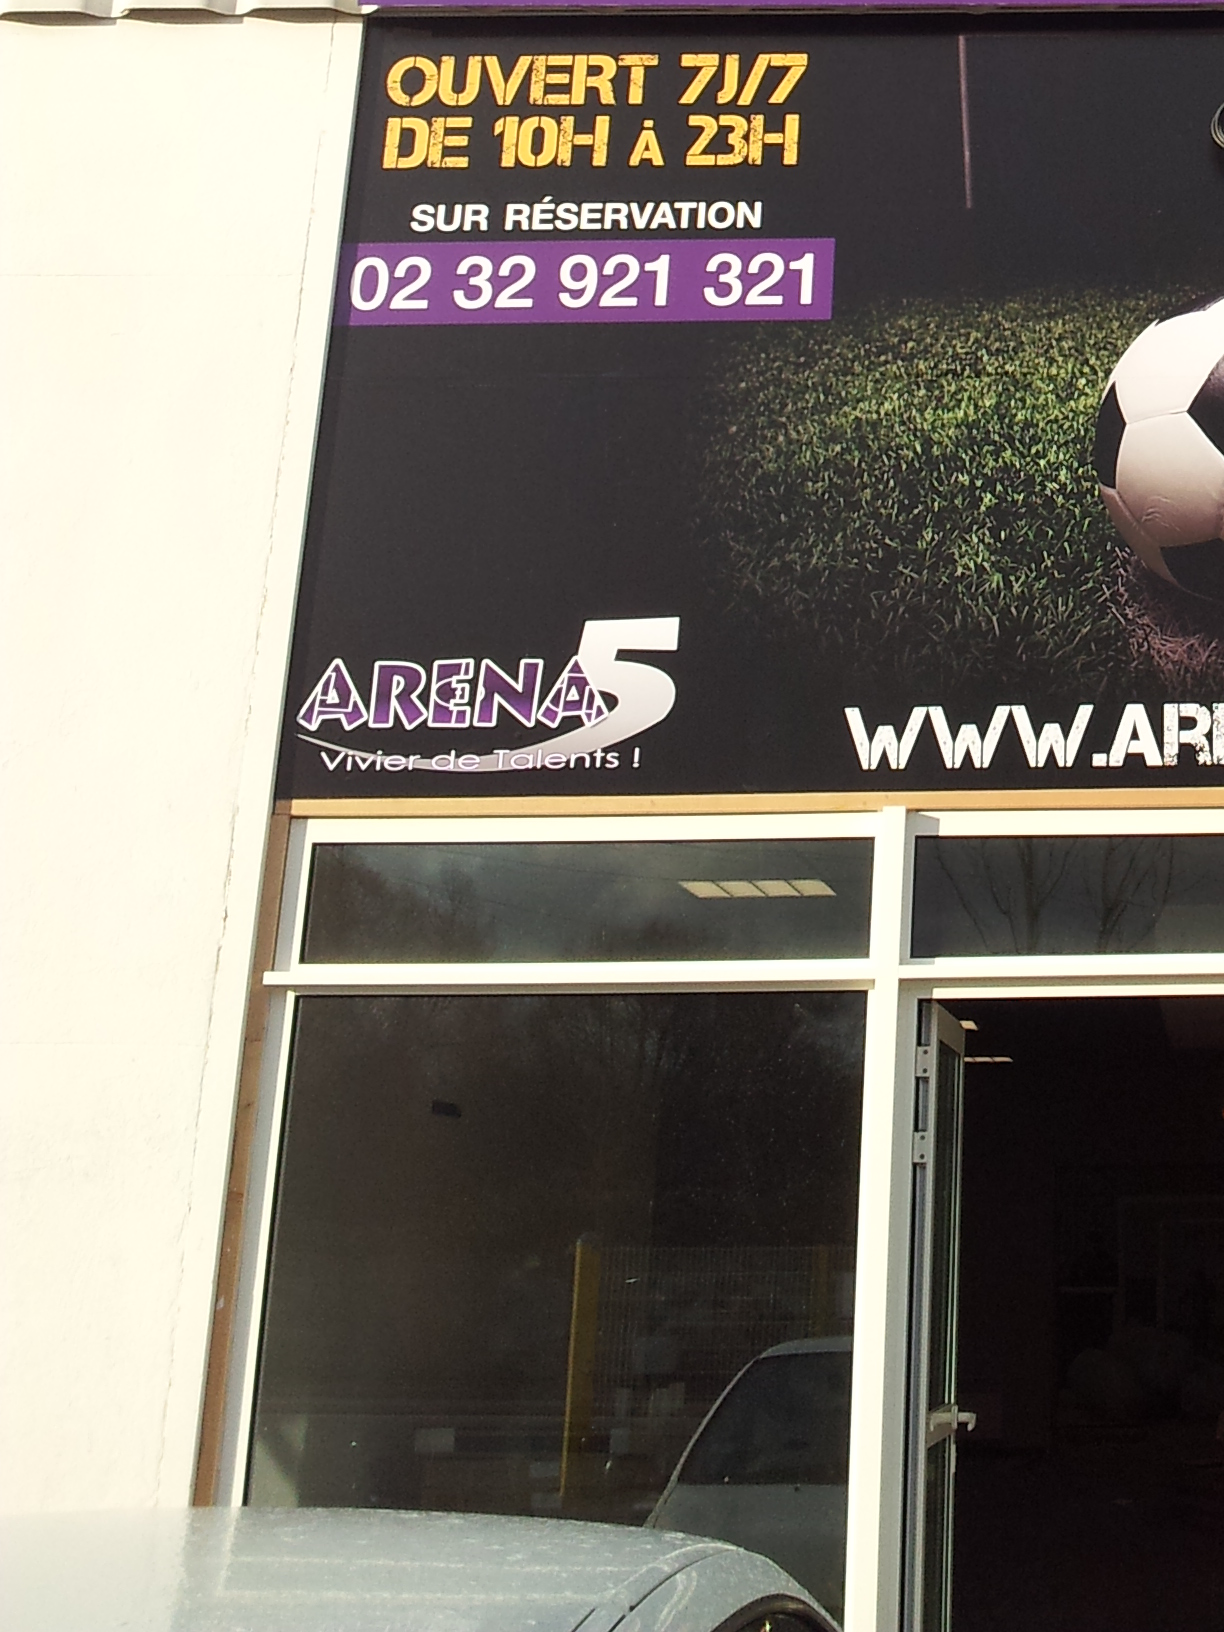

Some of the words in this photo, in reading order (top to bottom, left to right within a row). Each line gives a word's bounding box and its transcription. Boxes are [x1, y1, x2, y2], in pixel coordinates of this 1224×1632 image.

[386, 54, 660, 107] OUVERT
[678, 52, 809, 107] 7J/7
[381, 117, 474, 170] DE
[493, 115, 612, 169] 10H
[685, 113, 801, 167] 23H
[409, 202, 490, 232] SUR
[503, 196, 764, 232] RÉSERVATION
[350, 255, 433, 311] 02
[452, 254, 537, 310] 32
[557, 253, 672, 308] 921
[702, 251, 817, 307] 321
[297, 658, 608, 730] ARENA
[319, 751, 421, 772] Vivier
[431, 751, 481, 770] de
[493, 747, 620, 769] Talents
